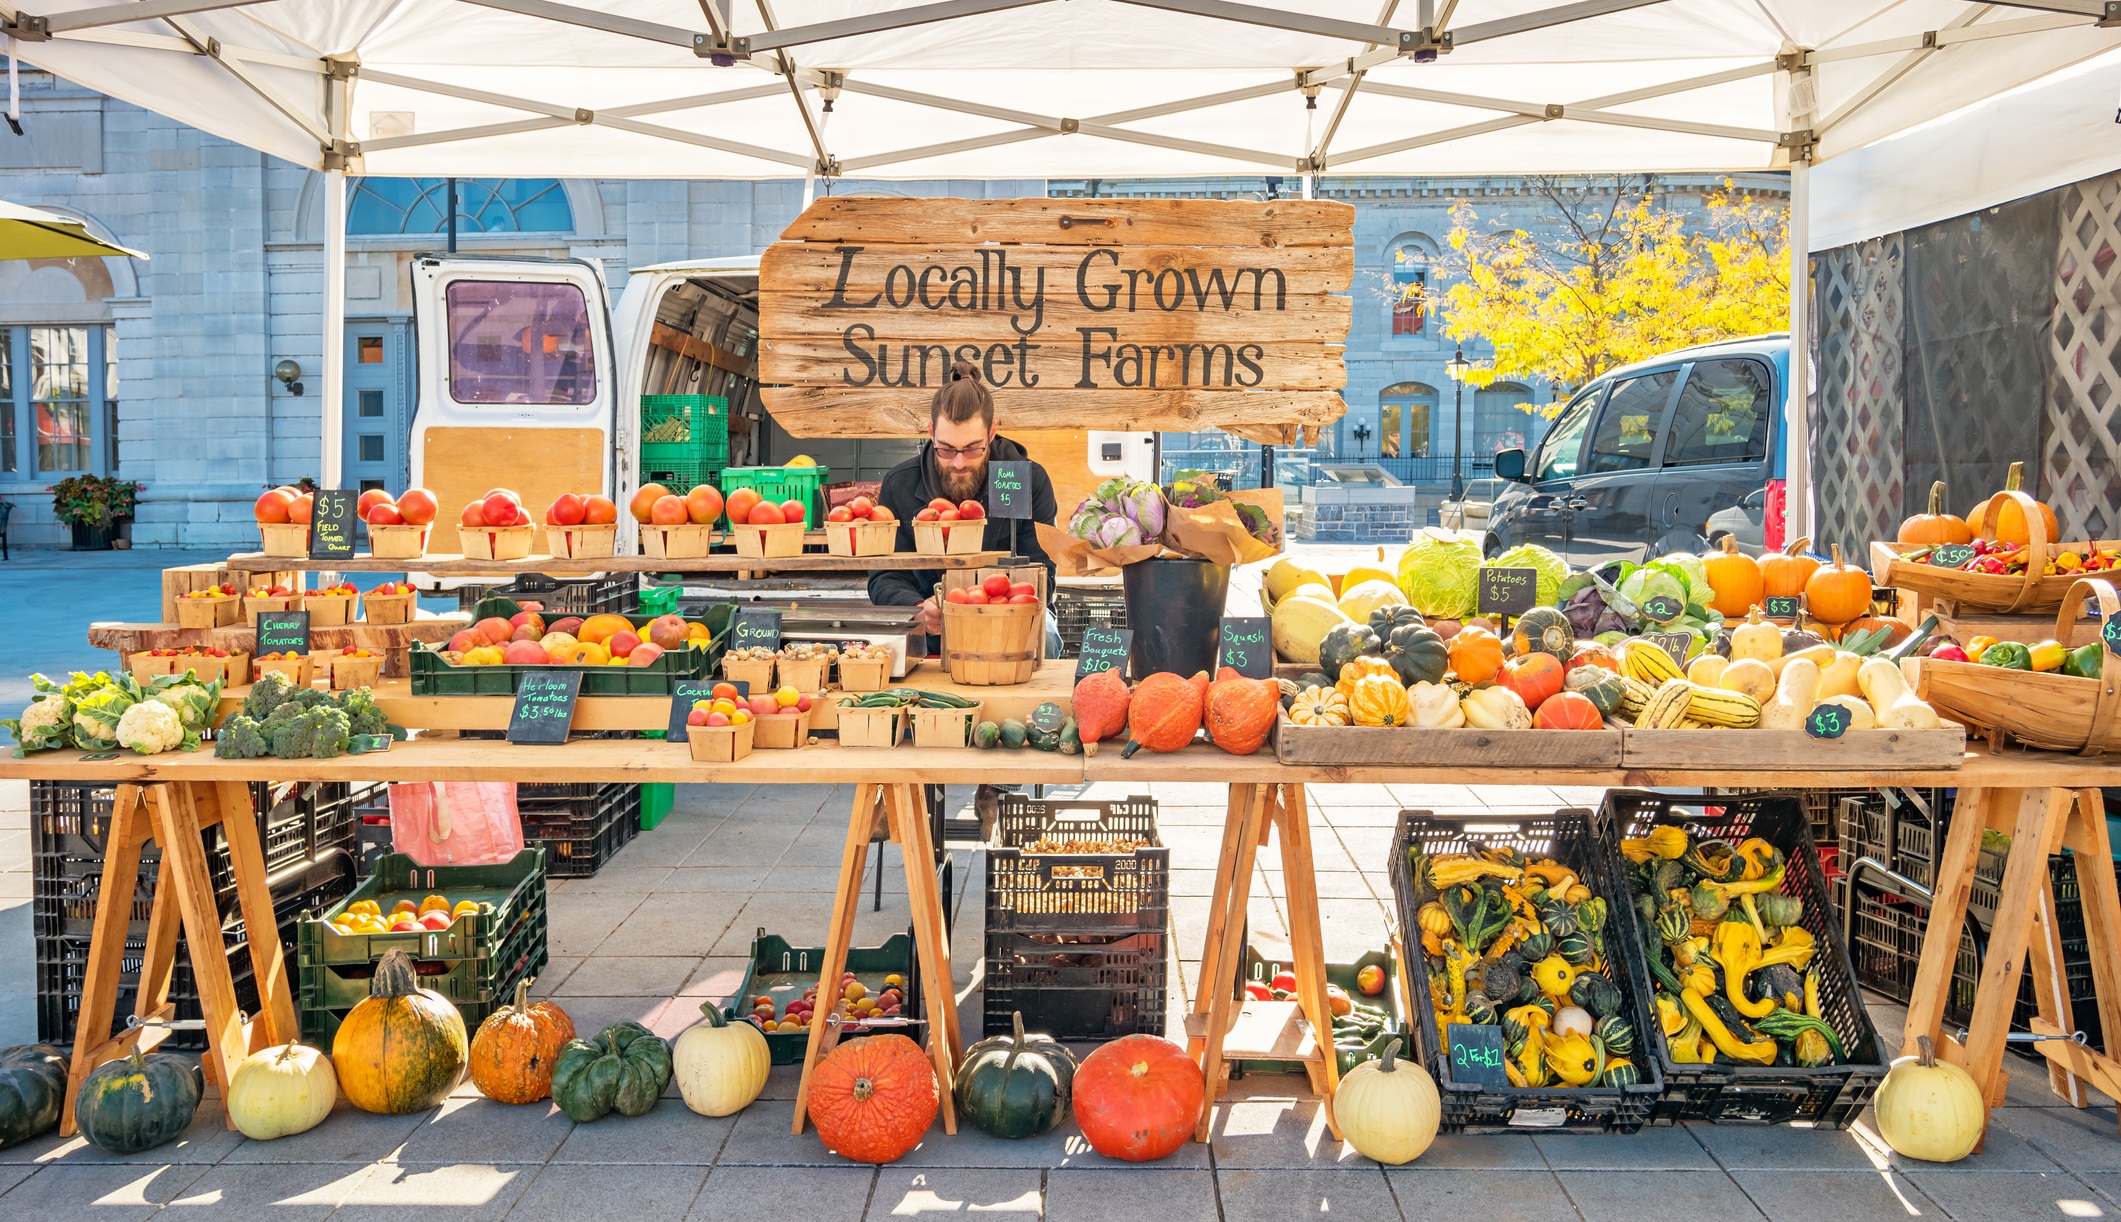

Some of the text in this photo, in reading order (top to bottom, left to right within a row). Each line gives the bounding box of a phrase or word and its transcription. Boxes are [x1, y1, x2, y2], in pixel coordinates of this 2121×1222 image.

[821, 246, 1287, 334] Locally Grown
[1074, 327, 1264, 388] Farms
[317, 494, 346, 518] $5
[1000, 493, 1011, 506] $5
[317, 519, 339, 533] FIELD
[1486, 568, 1527, 586] Potatoes
[1489, 584, 1511, 603] $5
[1645, 601, 1674, 616] $2
[1770, 599, 1791, 614] $3
[263, 619, 301, 631] CHERRY
[736, 621, 780, 639] GROUND
[260, 631, 304, 646] TOMATOES
[1086, 627, 1122, 644] Fresh
[1223, 624, 1265, 646] Squash
[1082, 641, 1128, 658] Bouquets
[1225, 648, 1248, 668] $3
[1082, 657, 1111, 673] $10
[522, 676, 567, 692] Heirloom
[522, 690, 568, 703] Tomatoes
[1815, 711, 1840, 735] $3
[1115, 859, 1137, 870] 2000
[1453, 1043, 1470, 1069] 2
[1483, 1045, 1502, 1069] $1
